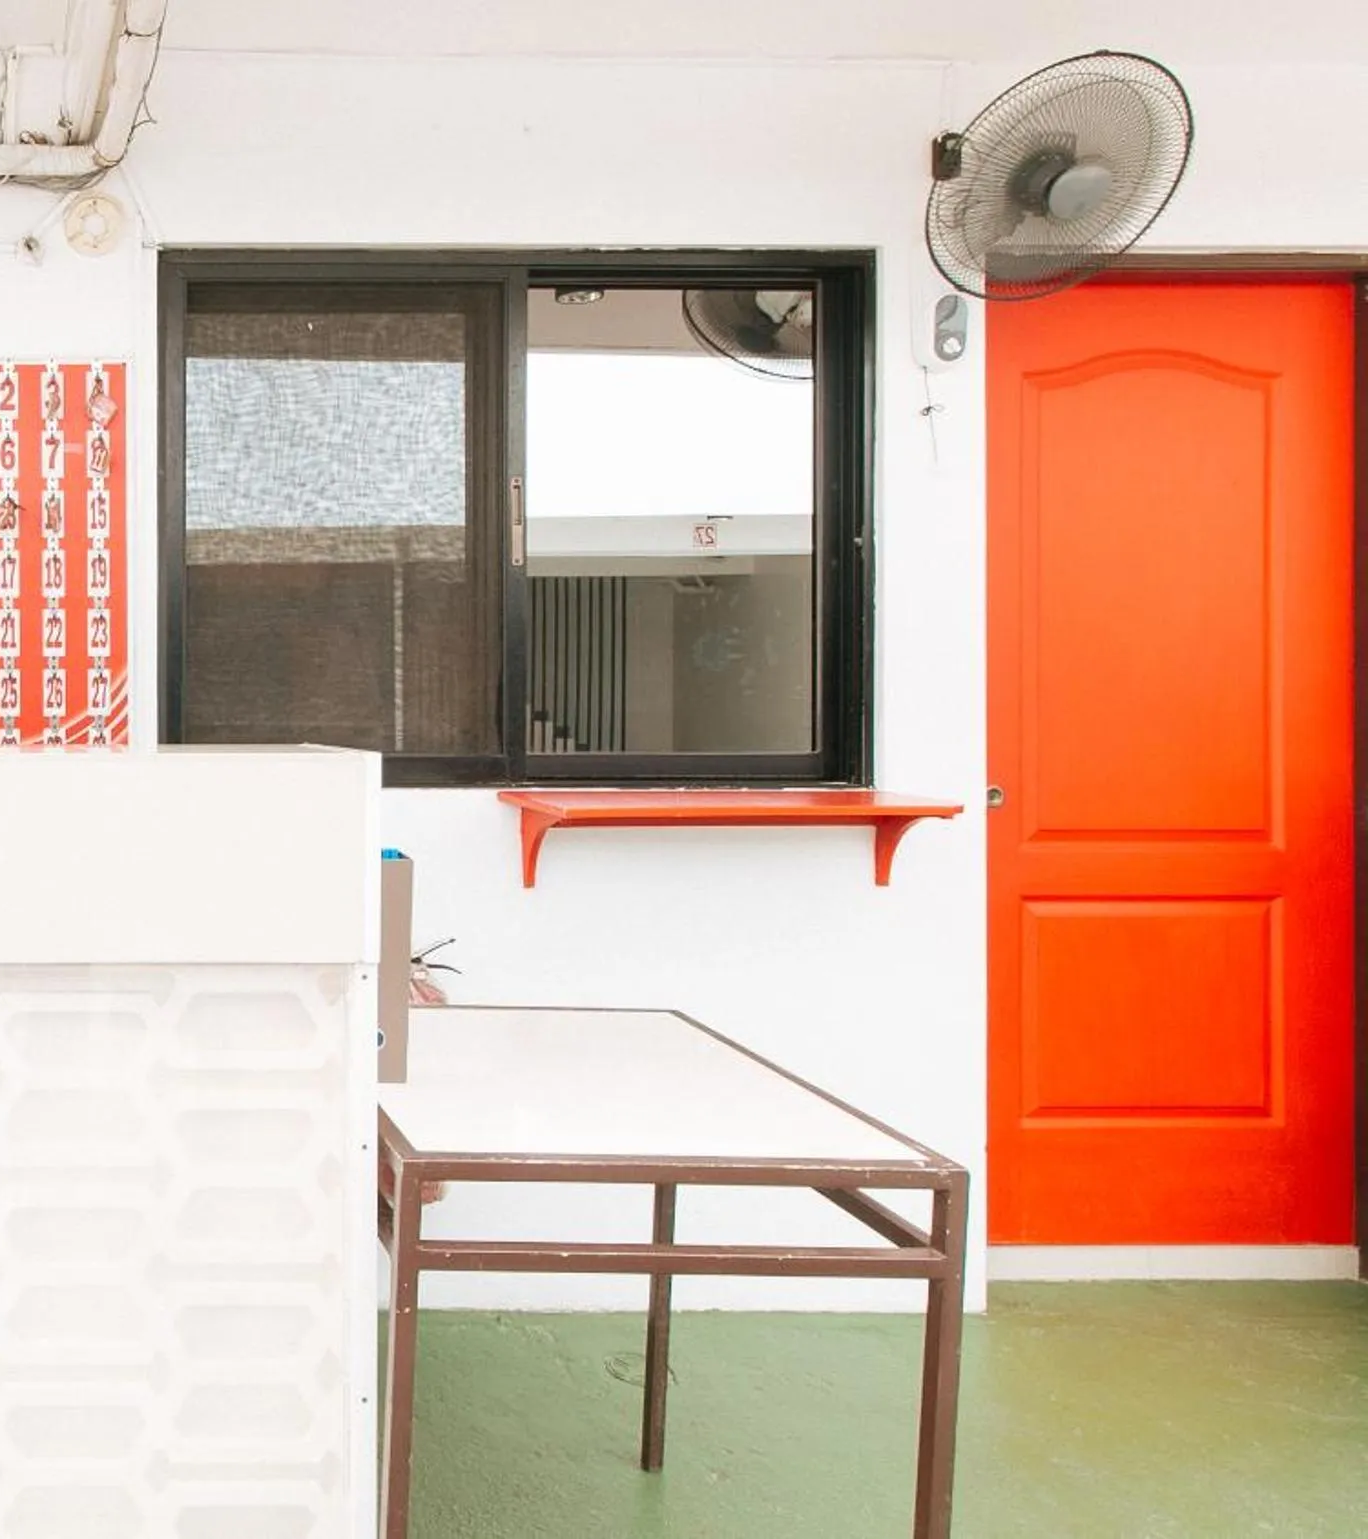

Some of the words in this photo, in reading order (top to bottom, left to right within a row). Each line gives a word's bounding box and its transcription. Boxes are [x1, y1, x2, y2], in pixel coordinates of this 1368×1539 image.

[0, 377, 16, 412] 2
[0, 438, 15, 470] 6
[45, 437, 60, 469] 7
[91, 496, 107, 530] 15
[0, 556, 17, 589] 17
[45, 556, 62, 589] 18
[91, 556, 108, 589] 19
[0, 616, 17, 649] 21
[45, 616, 62, 649] 22
[91, 616, 108, 649] 23
[0, 676, 17, 708] 25
[45, 676, 62, 708] 26
[91, 676, 108, 708] 27
